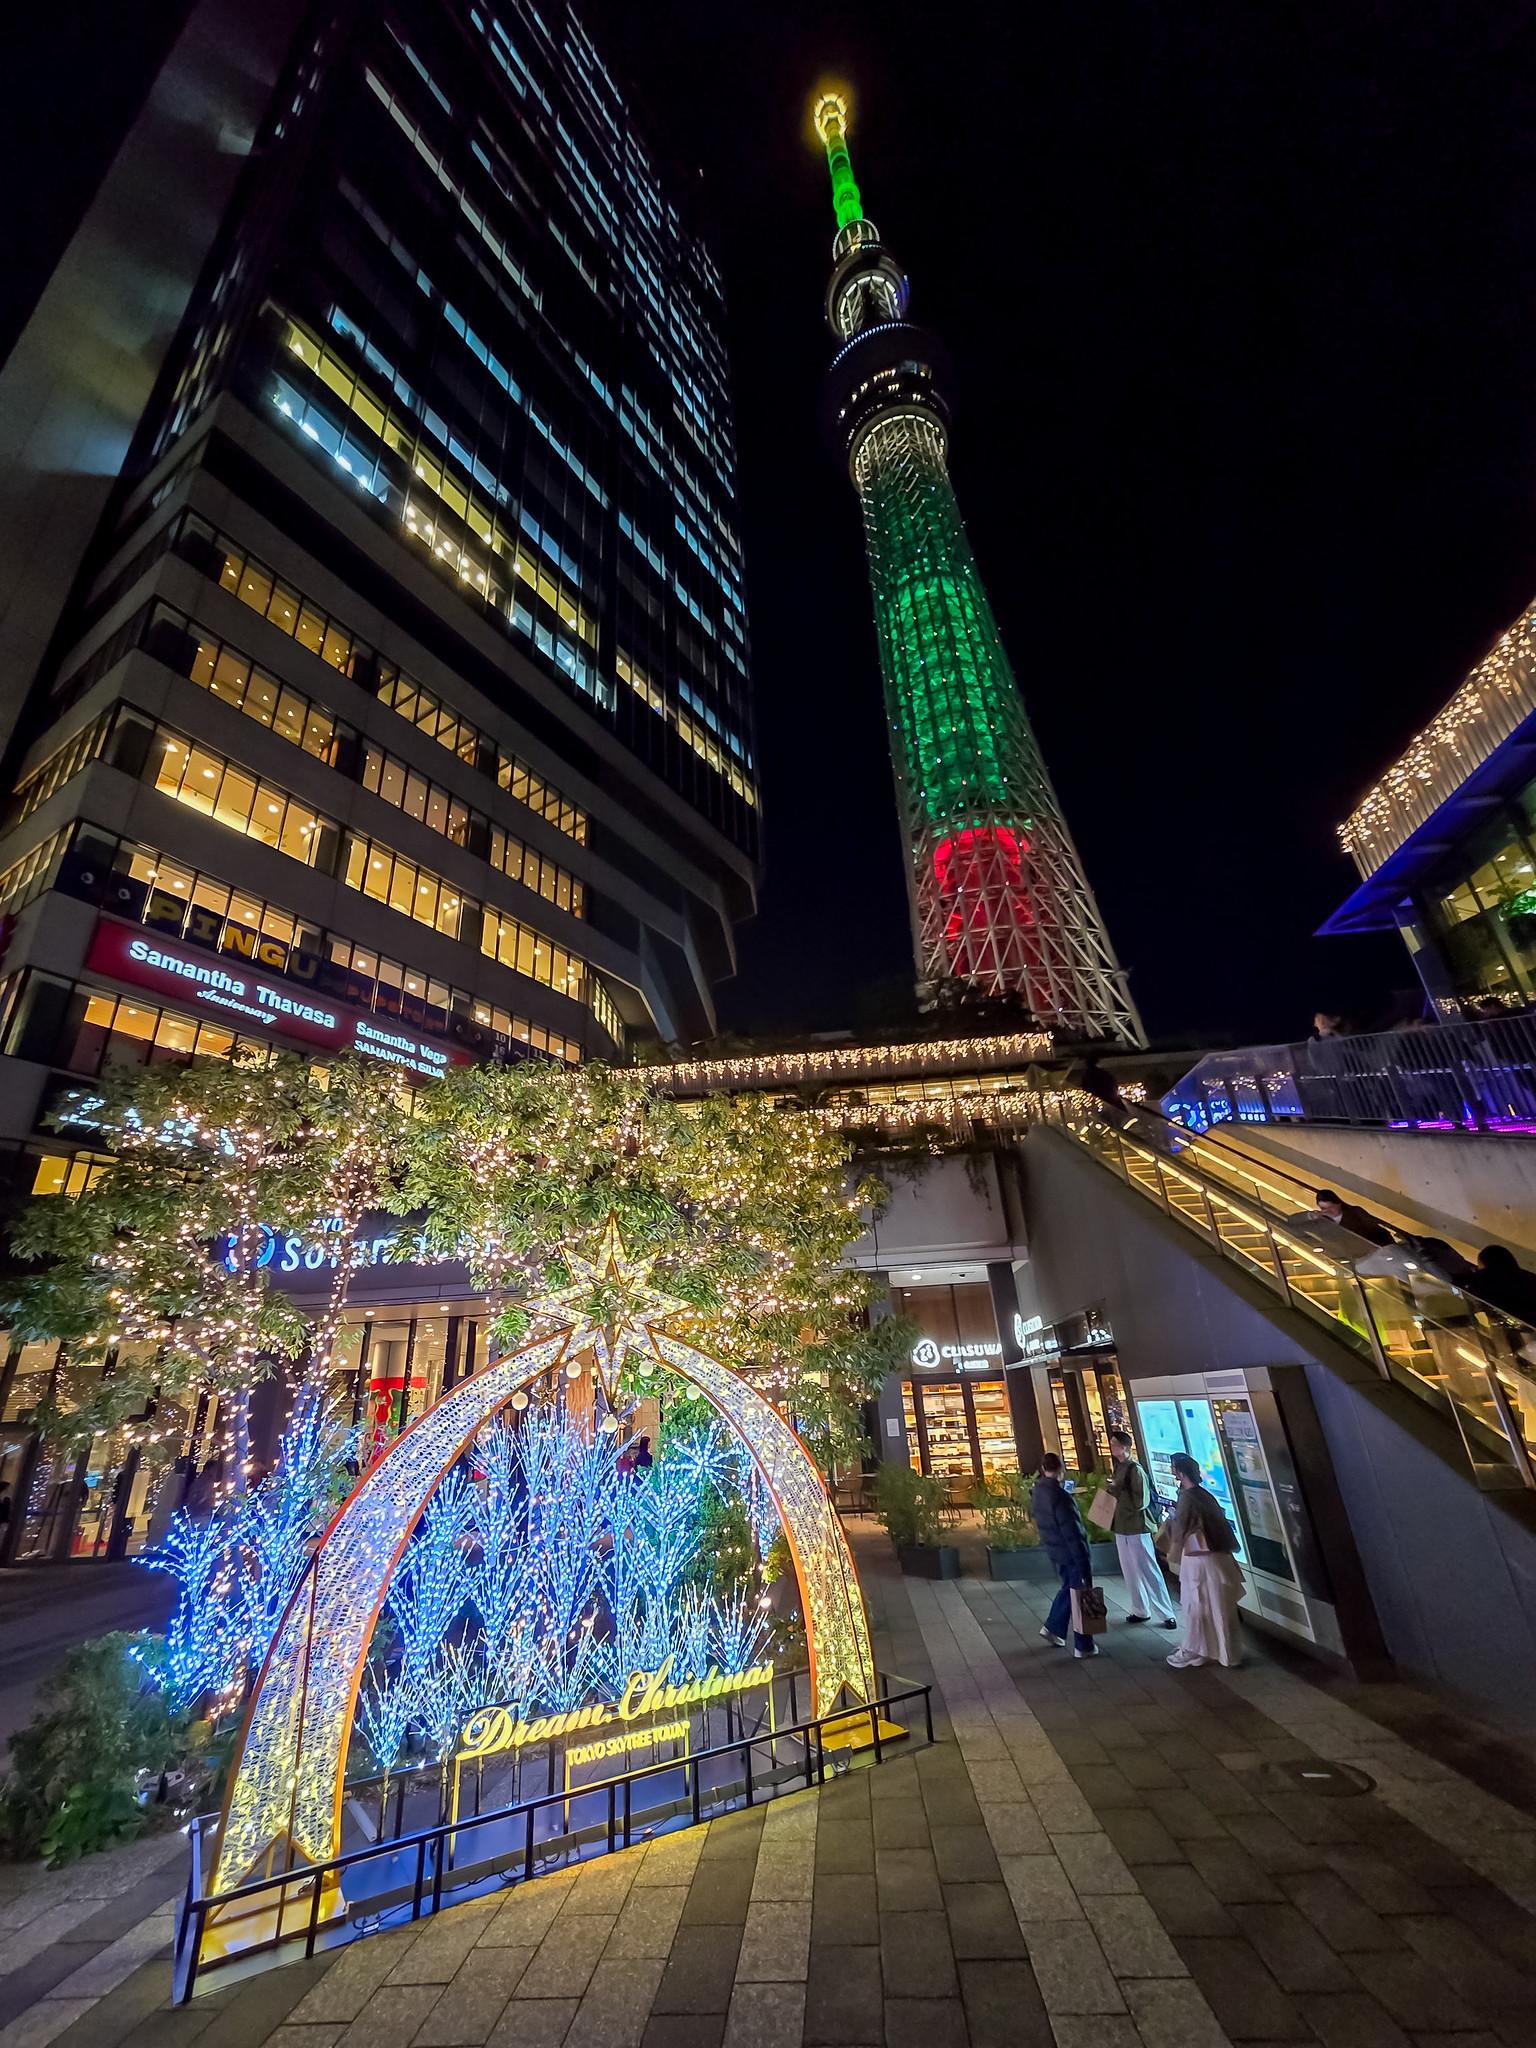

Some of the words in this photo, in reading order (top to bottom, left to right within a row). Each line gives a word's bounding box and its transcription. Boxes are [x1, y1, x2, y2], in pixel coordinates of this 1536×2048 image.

[150, 895, 319, 979] PINGU
[129, 940, 246, 996] Samantha
[256, 985, 336, 1029] Thavasa
[196, 989, 278, 1024] Anniversary
[356, 1021, 417, 1054] Samantha
[419, 1045, 448, 1065] Vega
[455, 1703, 612, 1760] Dream
[618, 1654, 774, 1721] Christmas
[565, 1742, 606, 1767] TOKYO
[606, 1730, 652, 1756] SKYTREE
